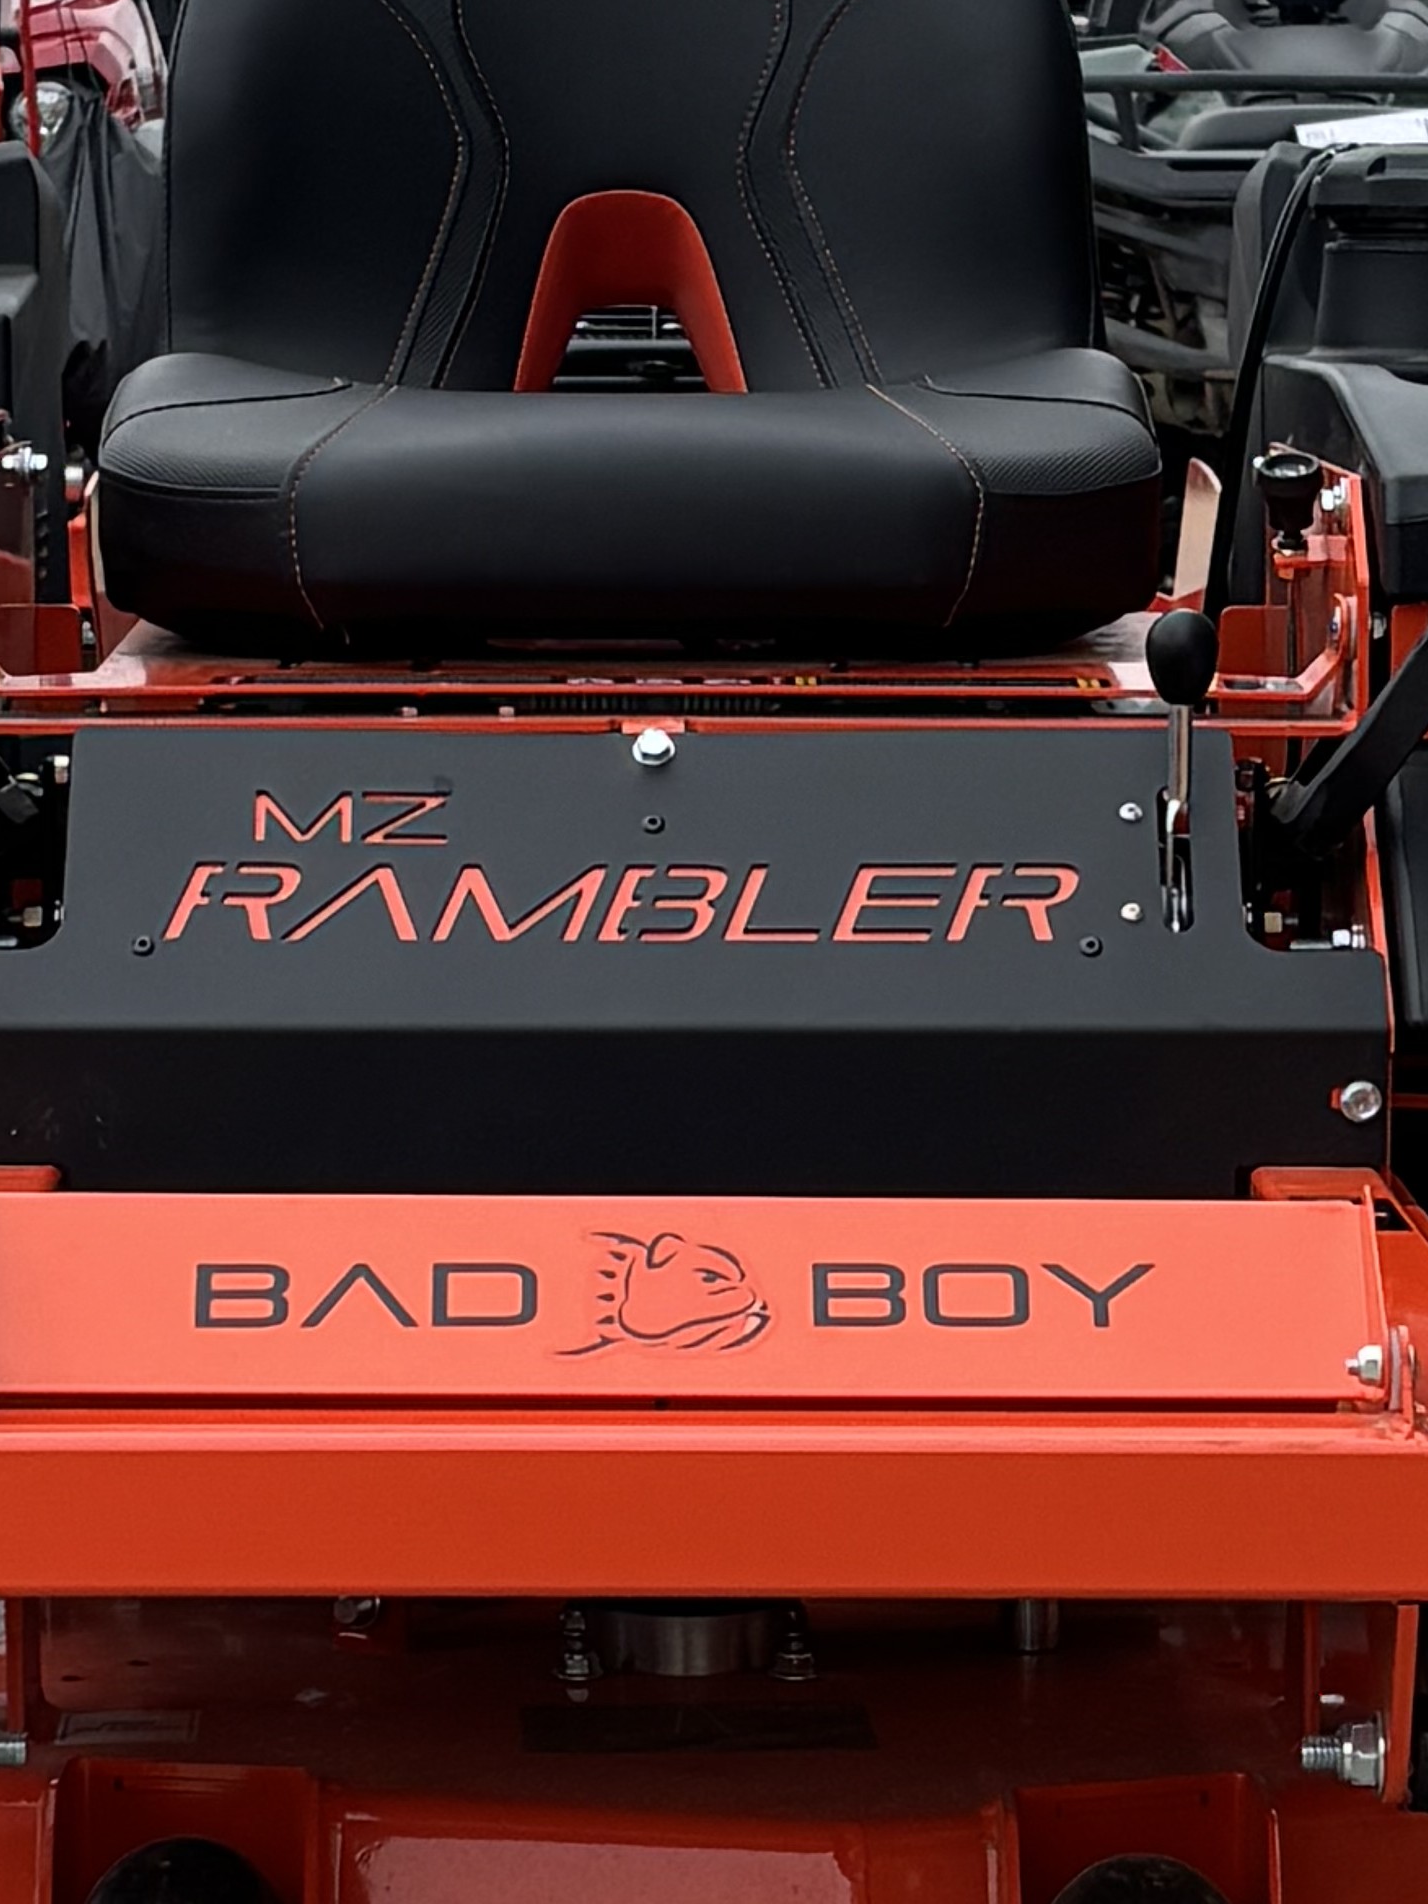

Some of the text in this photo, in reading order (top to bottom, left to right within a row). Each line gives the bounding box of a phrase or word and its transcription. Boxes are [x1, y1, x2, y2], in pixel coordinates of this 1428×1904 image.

[254, 788, 451, 846] MZ
[162, 861, 1080, 943] RAMBLER
[193, 1262, 1156, 1328] BAD BOY
